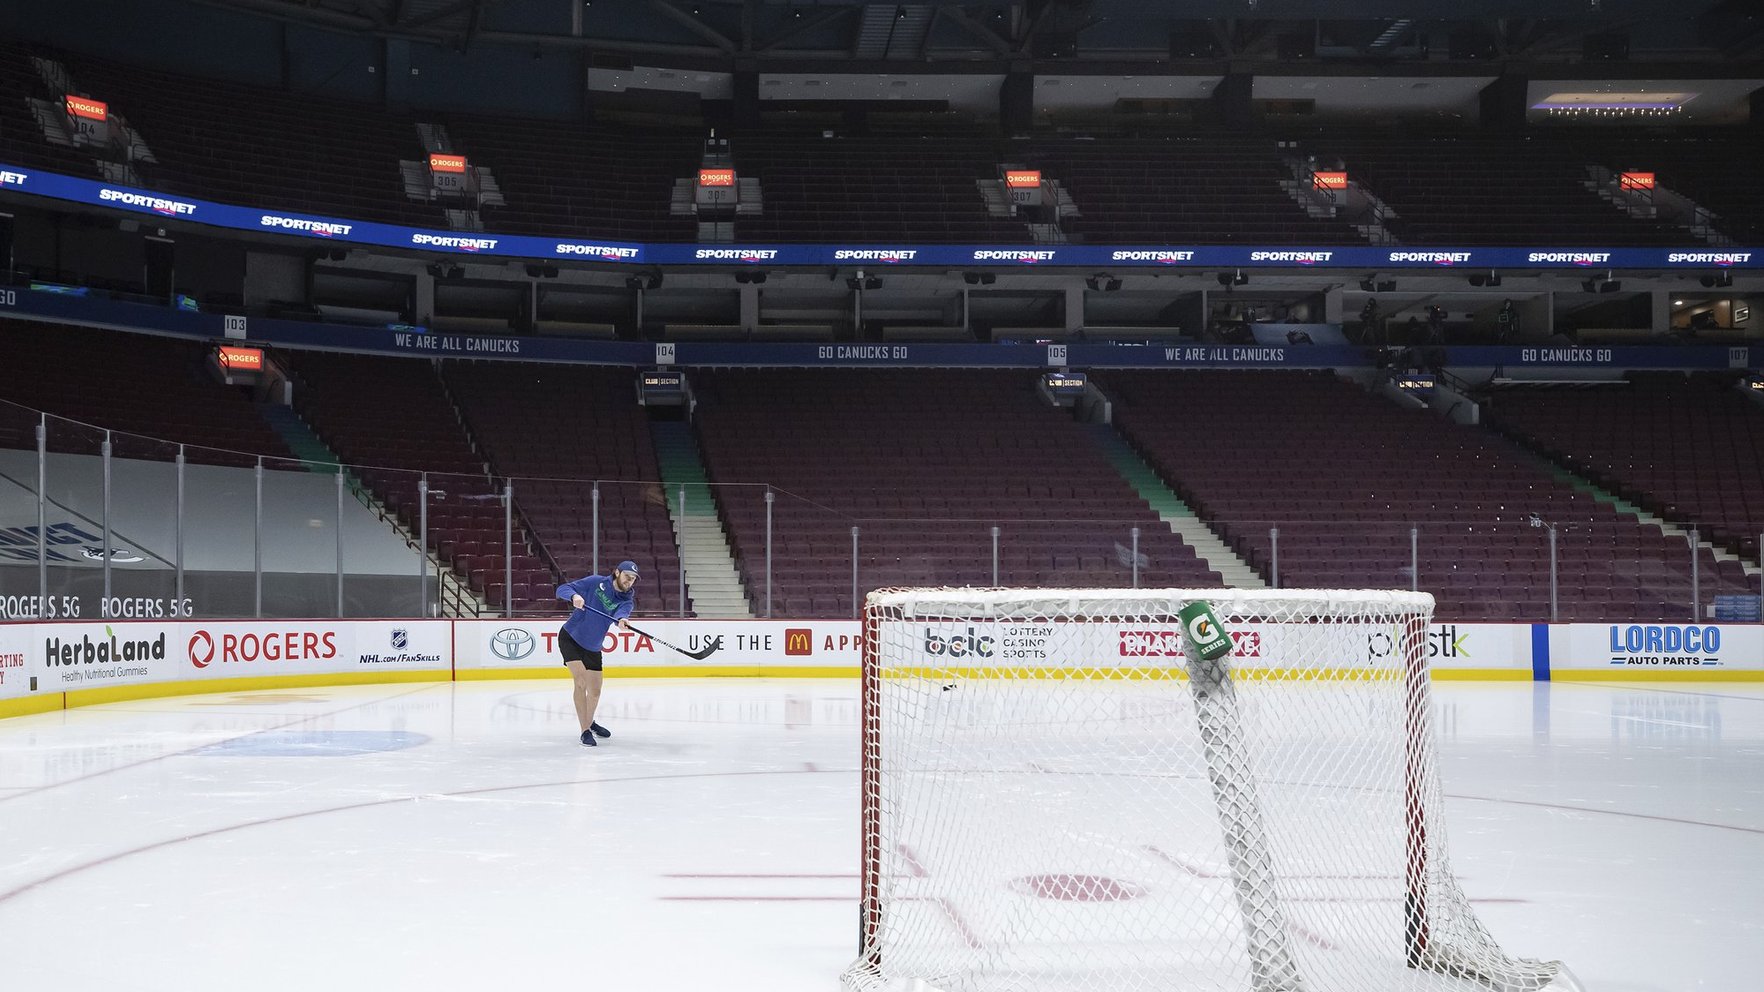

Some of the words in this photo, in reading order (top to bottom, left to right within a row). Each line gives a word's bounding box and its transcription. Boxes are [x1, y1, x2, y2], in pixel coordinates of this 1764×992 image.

[75, 102, 105, 115] ROGERS
[438, 158, 464, 167] ROGERS
[438, 175, 456, 187] 305
[707, 174, 732, 182] ROGERS
[1014, 175, 1039, 183] ROGERS
[99, 189, 196, 215] SPORTSNET
[1014, 191, 1031, 201] 307
[261, 216, 352, 235] SPORTSNET
[412, 234, 498, 249] SPORTSNET
[556, 244, 639, 258] SPORTSNET
[696, 250, 778, 260] SPORTSNET
[835, 250, 917, 260] SPORTSNET
[973, 250, 1056, 260] SPORTSNET
[1112, 251, 1194, 261] SPORTSNET
[1251, 252, 1332, 261] SPORTSNET
[1390, 252, 1471, 262] SPORTSNET
[1529, 252, 1611, 262] SPORTSNET
[1668, 252, 1751, 262] SPORTSNET
[226, 318, 245, 330] 103
[395, 333, 412, 347] WE
[416, 335, 438, 349] ARE
[442, 337, 462, 350] ALL
[466, 338, 520, 353] CANUCKS
[658, 346, 674, 356] 104
[819, 346, 833, 359] GO
[837, 346, 889, 359] CANUCKS
[893, 346, 908, 359] GO
[1049, 347, 1066, 358] 105
[1165, 348, 1181, 361] WE
[1185, 348, 1206, 361] ARE
[1210, 348, 1228, 361] ALL
[1232, 348, 1284, 361] CANUCKS
[1522, 349, 1537, 361] GO
[1541, 349, 1593, 361] CANUCKS
[1597, 349, 1612, 361] GO
[1731, 350, 1747, 360] 107
[229, 354, 260, 363] ROGERS
[62, 596, 80, 618] 5G
[101, 598, 162, 618] ROGERS
[171, 598, 193, 618] 5G
[223, 631, 337, 662] ROGERS
[541, 632, 655, 653] TOTA
[689, 635, 724, 651] USE
[737, 635, 772, 651] THE
[825, 635, 862, 651] APP
[1003, 639, 1045, 648] CASINO
[1368, 625, 1471, 665] plstk
[1610, 626, 1721, 655] LORDCO
[1201, 639, 1226, 655] SERIES
[1627, 656, 1659, 666] AUTO
[1663, 656, 1700, 666] PARTS
[61, 670, 83, 682] Healthy
[84, 667, 116, 680] Nutritional
[117, 666, 148, 677] Gummies
